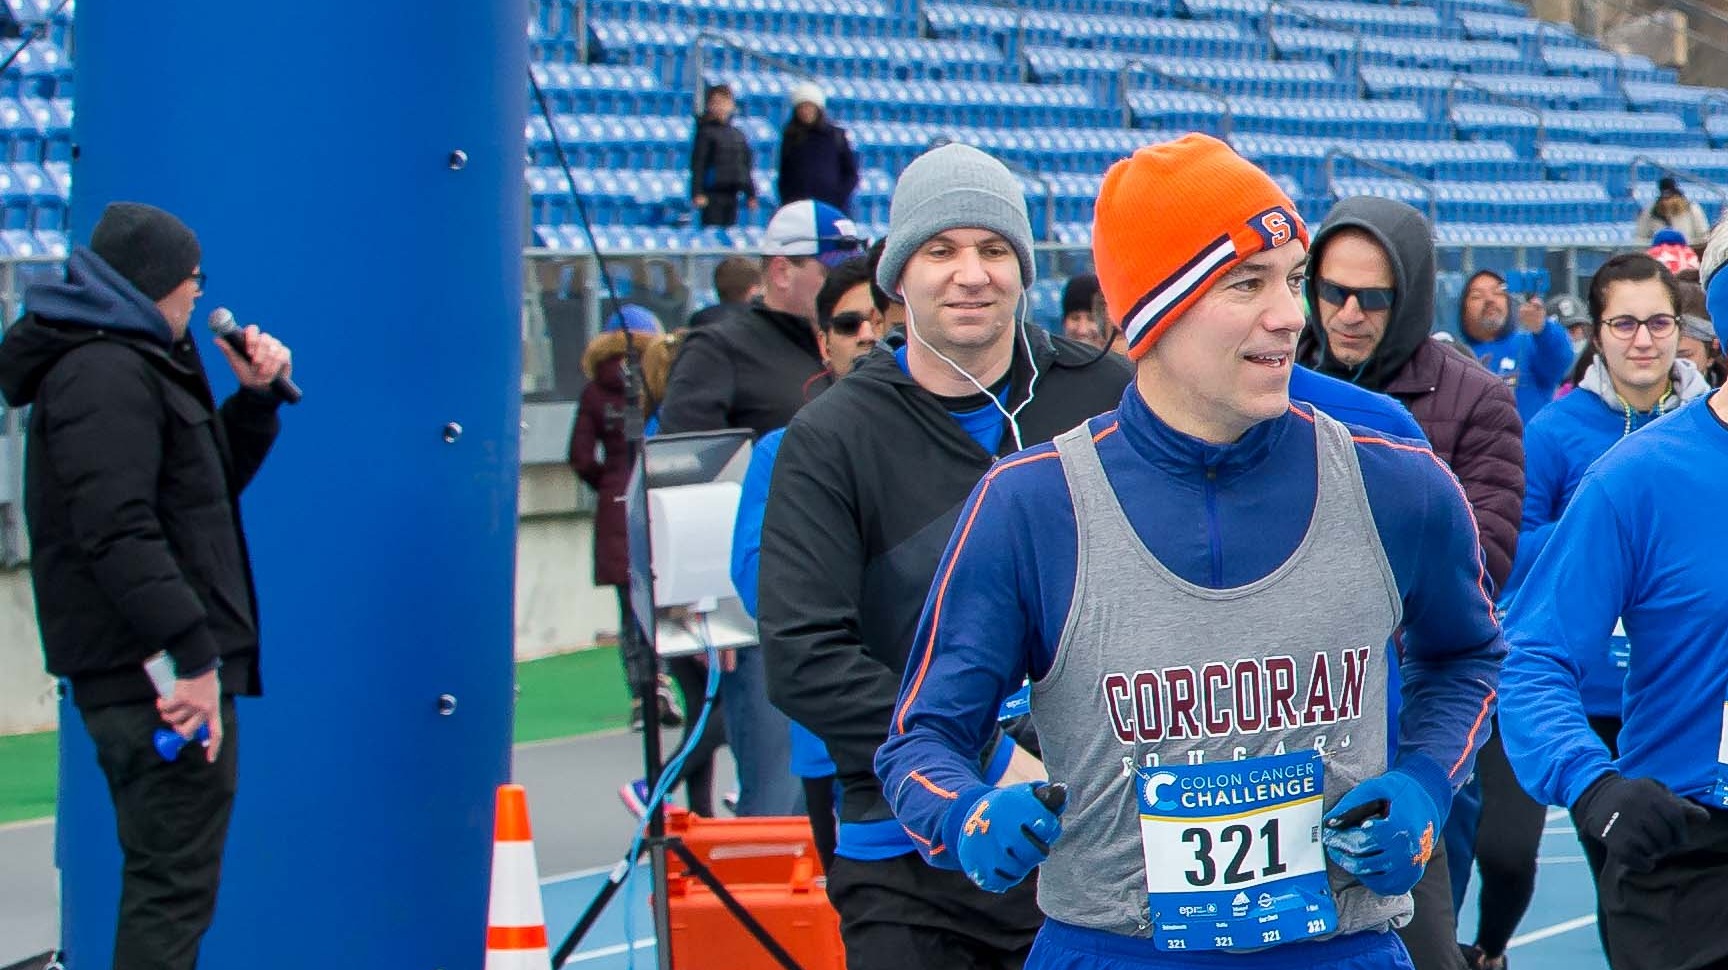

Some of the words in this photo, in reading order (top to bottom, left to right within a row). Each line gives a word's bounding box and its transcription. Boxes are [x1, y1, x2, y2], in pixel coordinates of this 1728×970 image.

[1103, 646, 1370, 745] CORCORAN
[1181, 771, 1243, 790] COLON
[1250, 762, 1315, 784] CANCER
[1181, 776, 1315, 808] CHALLENGE
[1181, 818, 1287, 887] 321
[1167, 939, 1187, 949] 321
[1214, 936, 1234, 947] 321
[1262, 930, 1281, 943] 321
